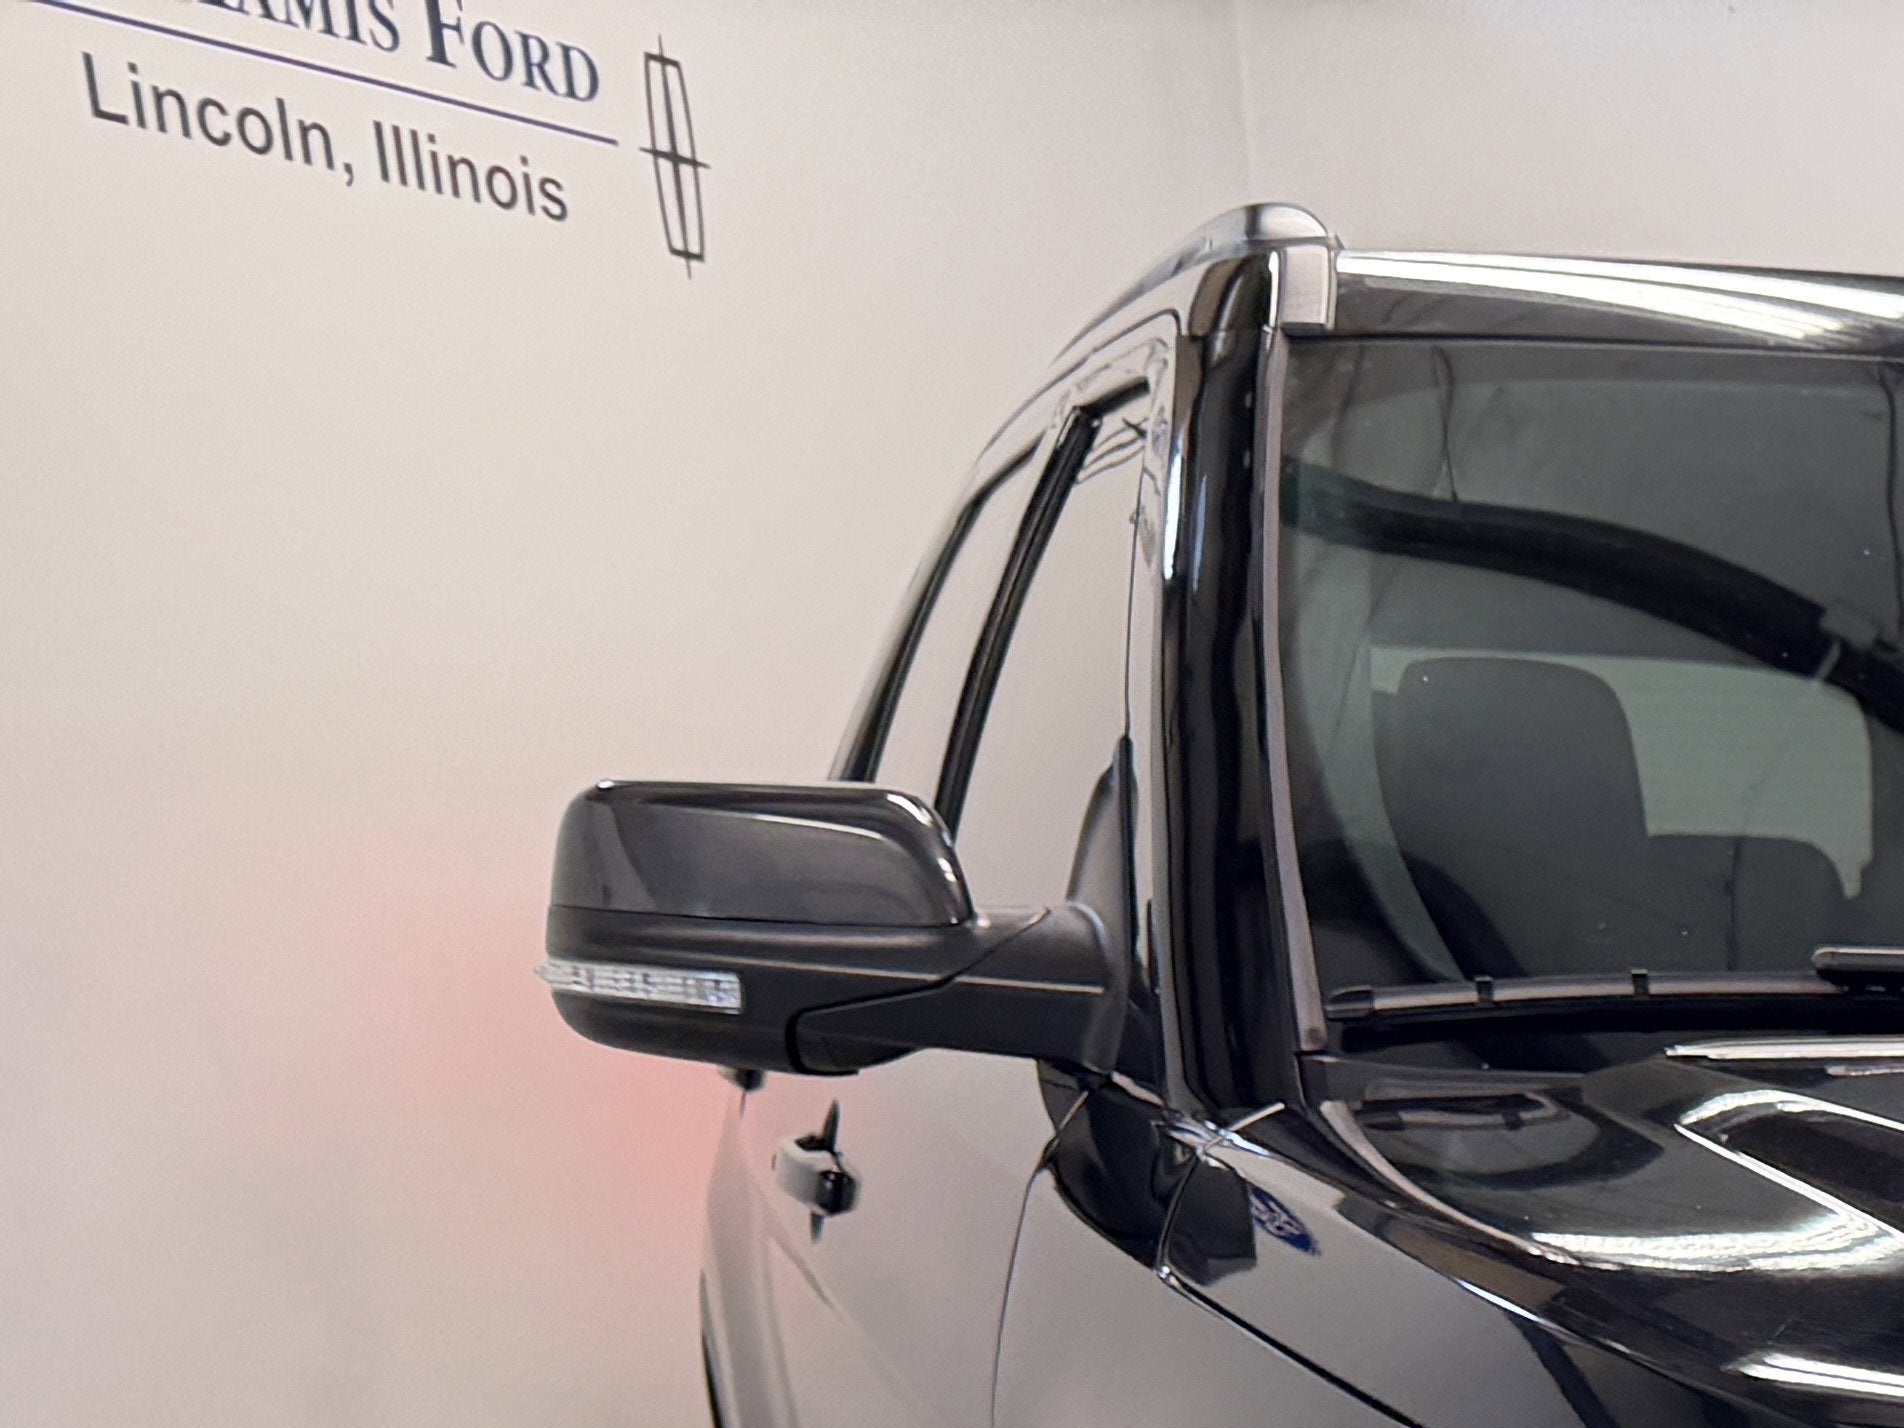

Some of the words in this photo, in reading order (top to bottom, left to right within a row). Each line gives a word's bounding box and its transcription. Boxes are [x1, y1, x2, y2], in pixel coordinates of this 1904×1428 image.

[199, 0, 400, 52] MIS
[425, 0, 600, 102] FORD
[82, 52, 355, 187] Lincoln,
[373, 120, 569, 222] Illinois
